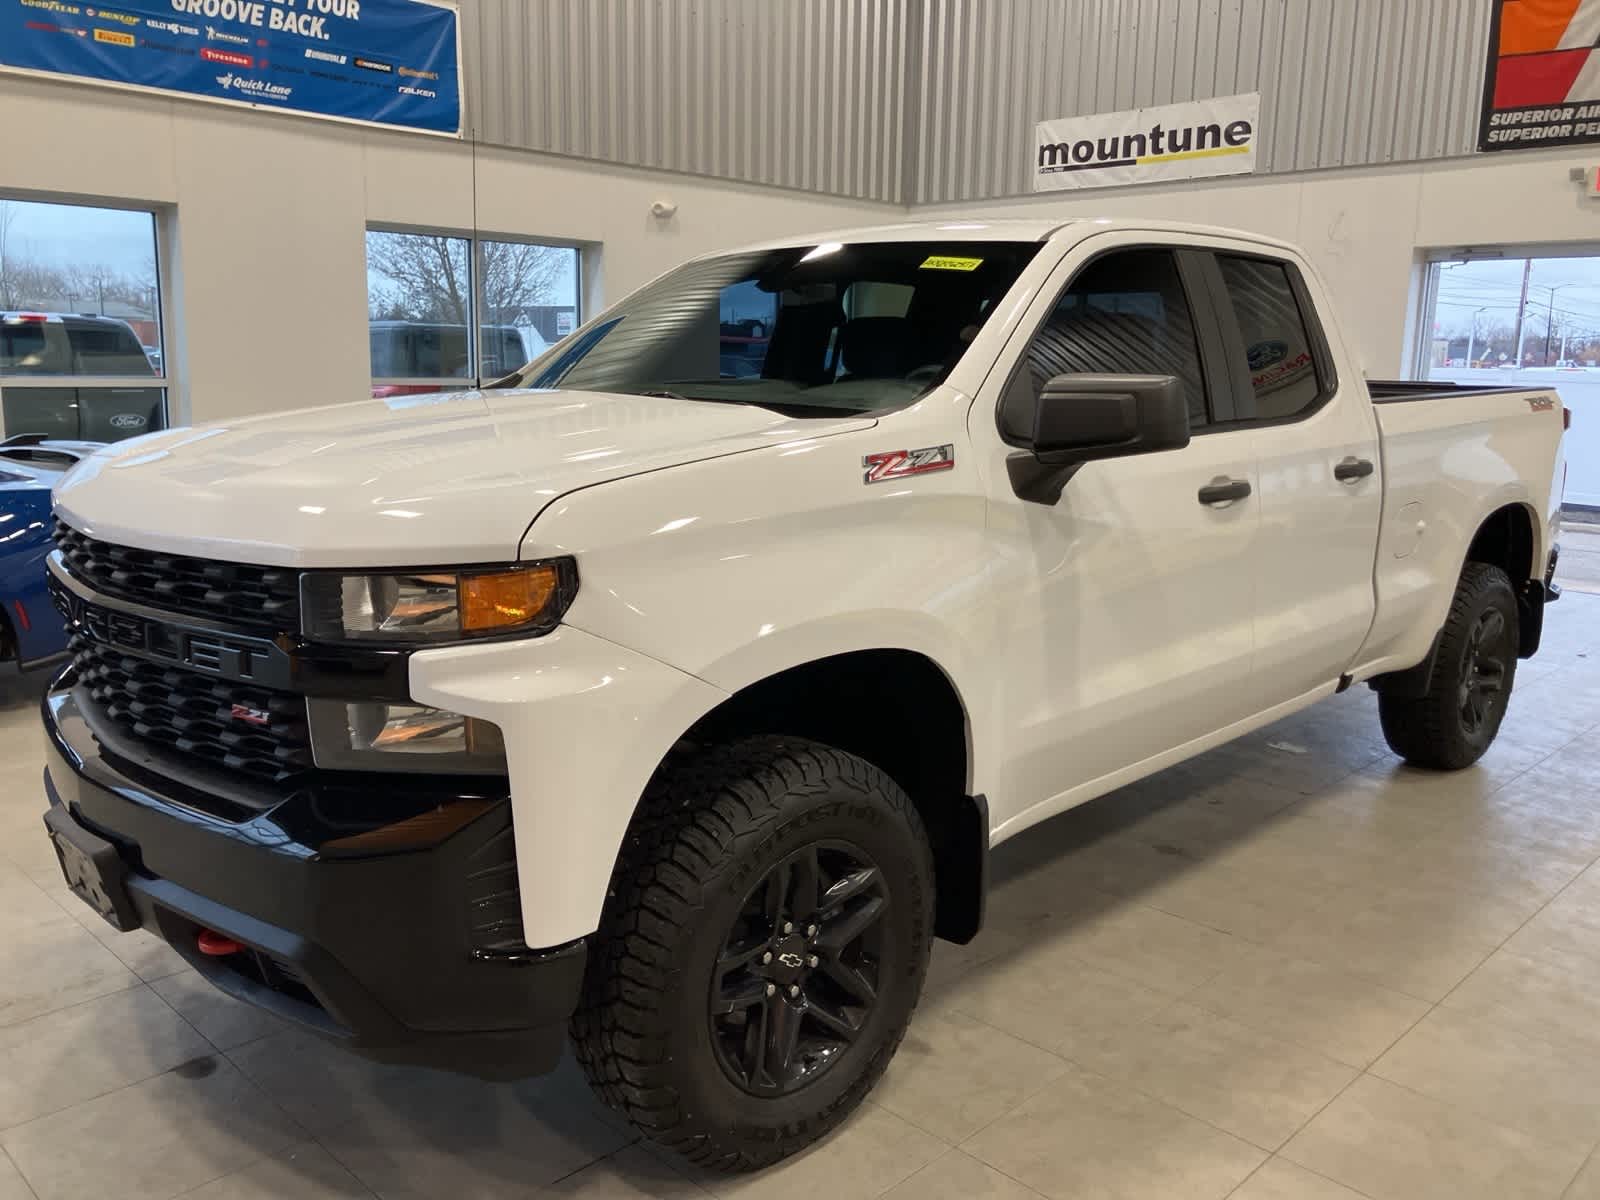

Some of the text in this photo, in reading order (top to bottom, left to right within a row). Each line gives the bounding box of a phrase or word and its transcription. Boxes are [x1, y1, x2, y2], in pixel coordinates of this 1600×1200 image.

[171, 0, 330, 40] GROOVE BACK.
[233, 77, 292, 95] Quick Lane
[1489, 108, 1575, 126] SUPERIOR
[1038, 120, 1252, 167] mountune
[1487, 124, 1573, 143] SUPERIOR
[862, 443, 955, 485] Z71
[231, 703, 271, 726] Z71
